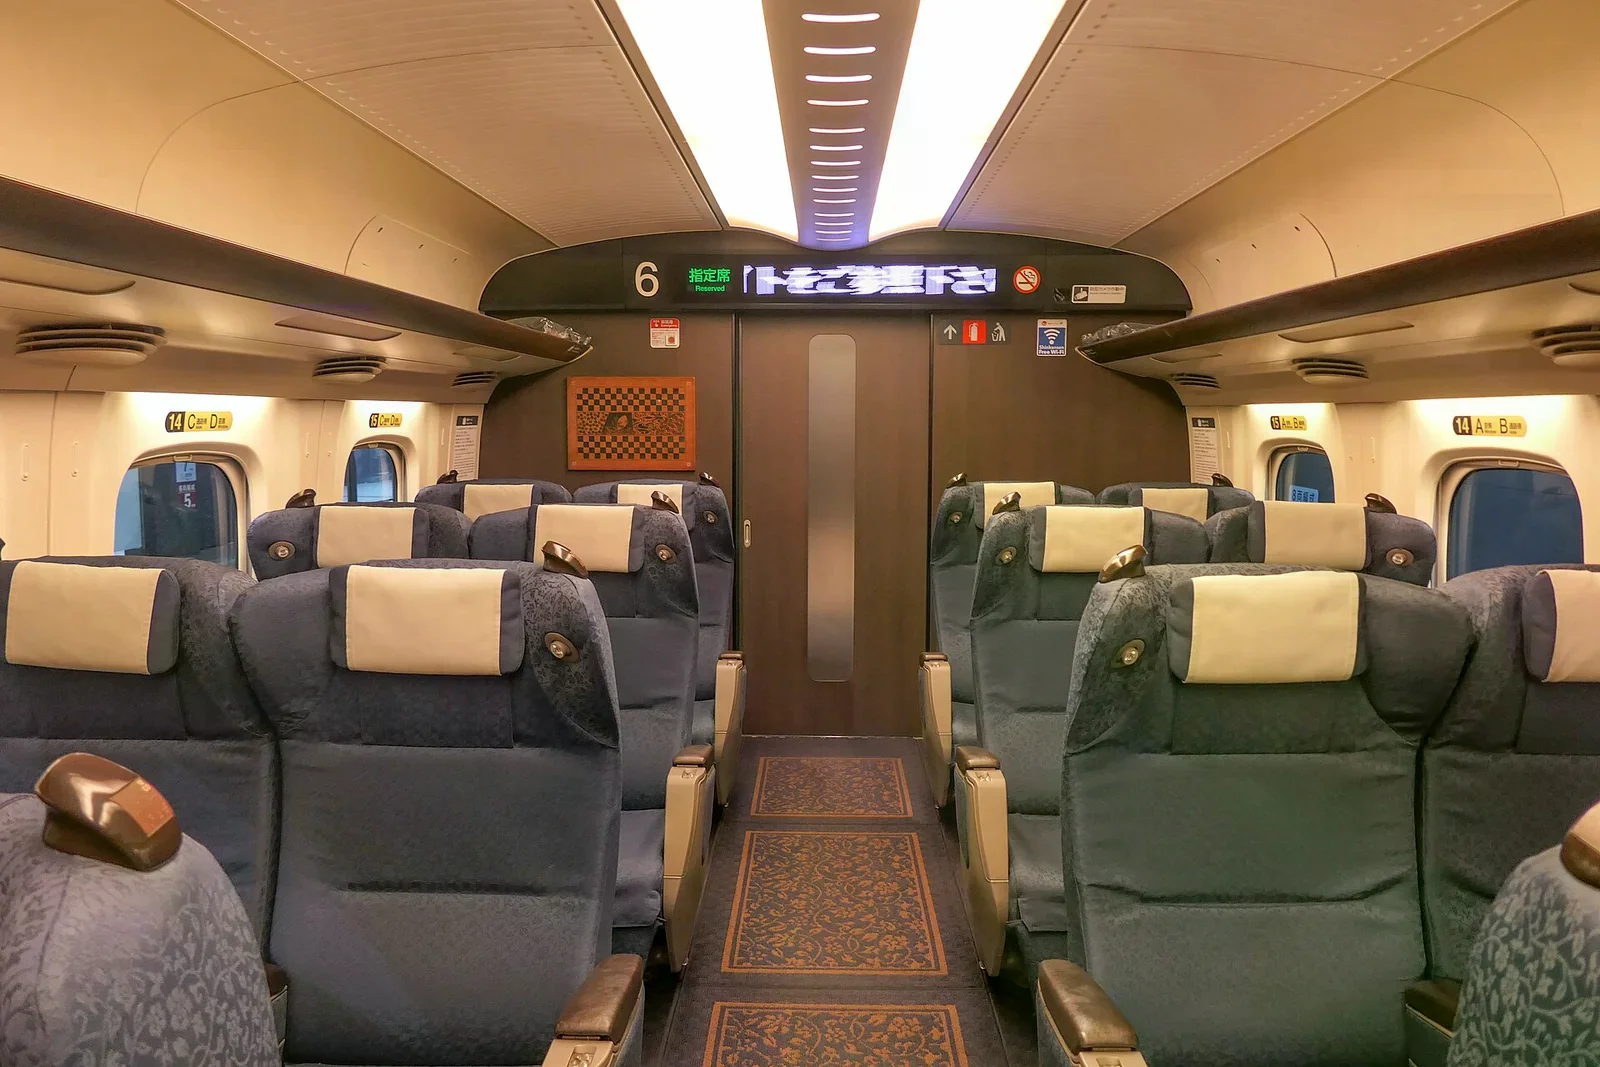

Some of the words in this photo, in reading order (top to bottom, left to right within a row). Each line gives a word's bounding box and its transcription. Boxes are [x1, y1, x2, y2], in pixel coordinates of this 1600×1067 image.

[634, 261, 660, 297] 6
[688, 268, 731, 283] 指定席
[169, 413, 182, 431] 14
[187, 413, 196, 430] C
[210, 414, 218, 429] D
[1271, 416, 1280, 429] 15
[1455, 417, 1470, 434] 14
[1475, 417, 1484, 433] A
[1499, 418, 1508, 434] B
[183, 493, 192, 508] 5
